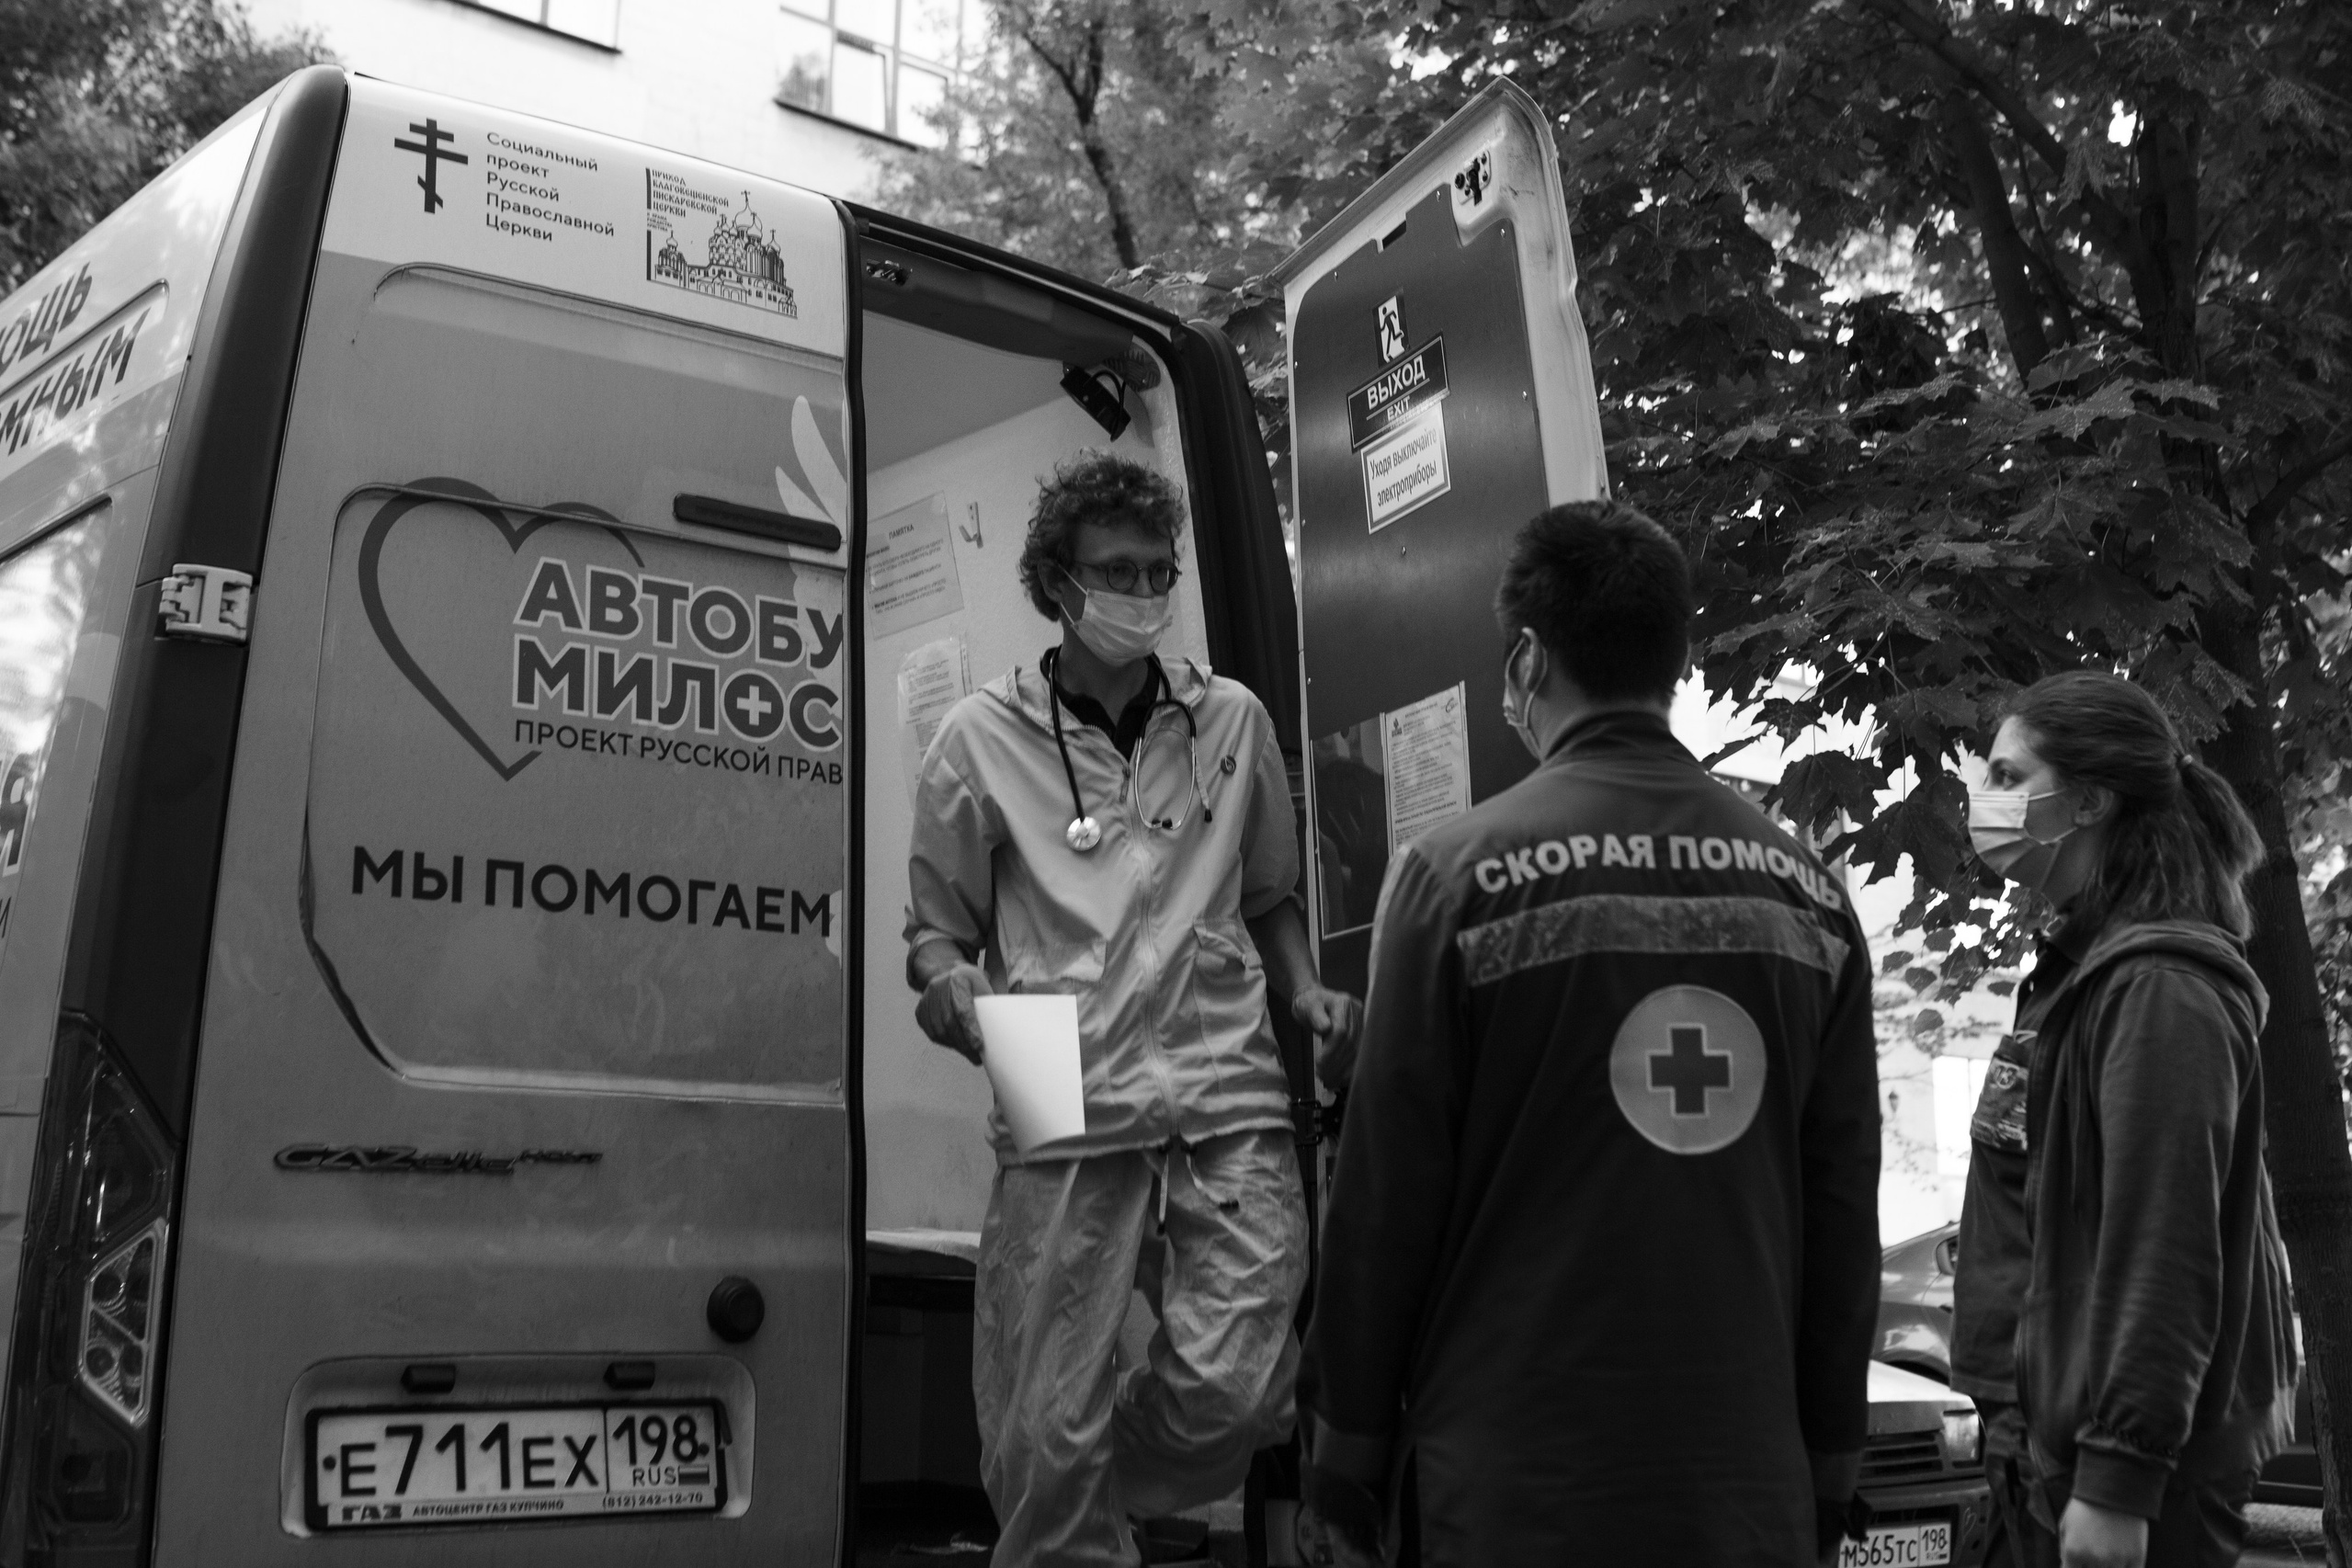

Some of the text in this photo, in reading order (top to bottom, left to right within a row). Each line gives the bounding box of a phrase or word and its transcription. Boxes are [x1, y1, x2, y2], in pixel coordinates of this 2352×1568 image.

[487, 131, 597, 171] Социальный
[487, 154, 550, 178] проект
[487, 171, 559, 201] Русской
[653, 169, 687, 187] ПРИХОД
[486, 212, 552, 242] Церкви
[487, 191, 614, 236] Православной
[653, 201, 686, 218] ЦЕРКВИ
[0, 261, 92, 378] ОЩЬ
[1367, 354, 1426, 410] ВЫХОД
[1387, 395, 1410, 422] EXIT
[1369, 427, 1437, 480] Уходя выключайте
[1378, 460, 1437, 506] электроприборы
[513, 556, 843, 669] АВТОБУ
[512, 632, 843, 752] МИЛОС
[515, 719, 843, 785] ПРОЕКТ РУССКОЙ ПРАВ
[352, 845, 830, 938] МЫ ПОМОГАЕМ
[1475, 834, 1842, 911] СКОРАЯ ПОМОЩЬ
[612, 1415, 699, 1466] 198
[631, 1467, 676, 1487] RUS
[341, 1505, 402, 1523] ГАЗ
[412, 1502, 483, 1517] АВТОЦЕНТР
[486, 1502, 507, 1514] ГАЗ
[509, 1499, 564, 1513] КУПЧИНО
[1922, 1527, 1948, 1552] 198
